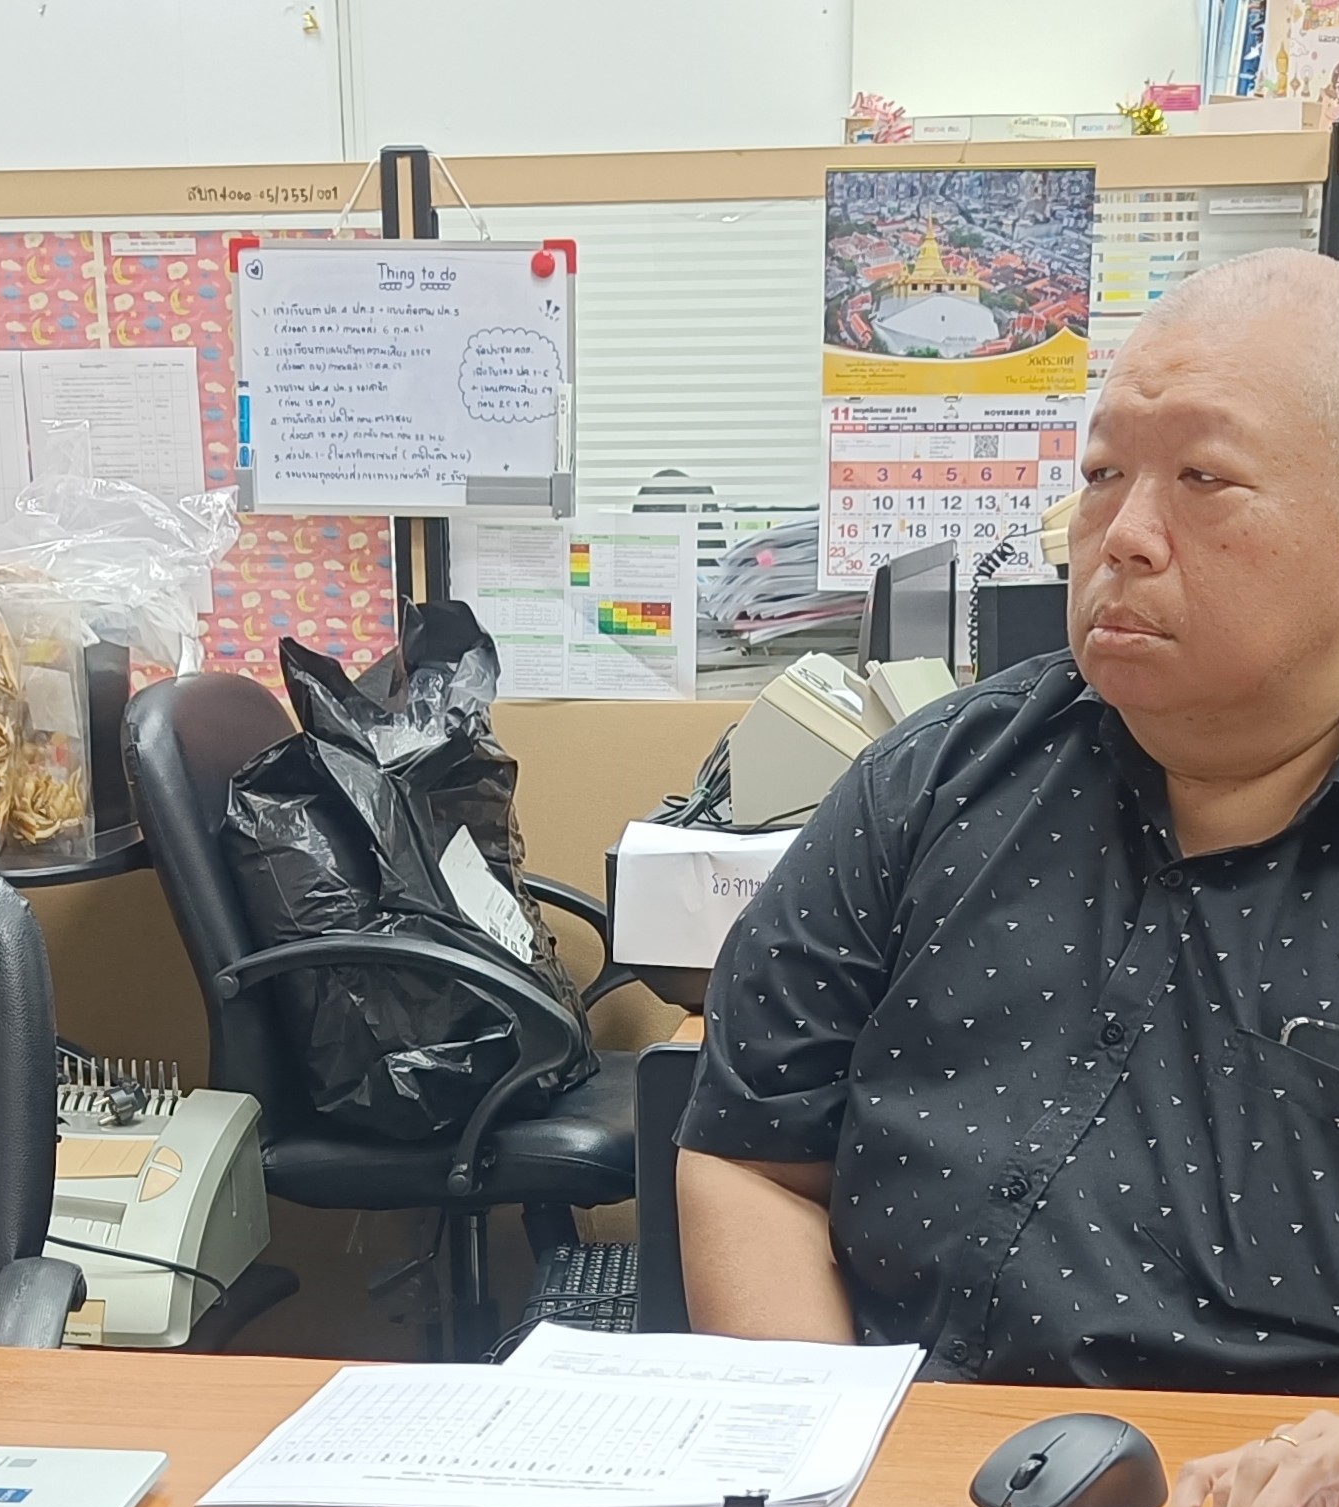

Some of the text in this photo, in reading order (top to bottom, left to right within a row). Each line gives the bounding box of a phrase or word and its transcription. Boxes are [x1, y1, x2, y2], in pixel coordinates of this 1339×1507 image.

[376, 262, 457, 289] Thing to do
[831, 407, 850, 421] 11
[984, 409, 1031, 417] NOVEMBER
[1052, 437, 1062, 451] 1
[843, 466, 1062, 482] 2 3 4 5 6 7 8
[842, 496, 853, 511] 9
[873, 495, 894, 510] 10
[906, 495, 926, 510] 11
[941, 495, 962, 510] 12
[975, 495, 996, 510] 13
[1010, 495, 1031, 510] 14
[838, 523, 1028, 538] 16 17 18 19 20 21
[830, 547, 863, 571] 23 30
[869, 552, 891, 566] 24
[1007, 551, 1029, 566] 28
